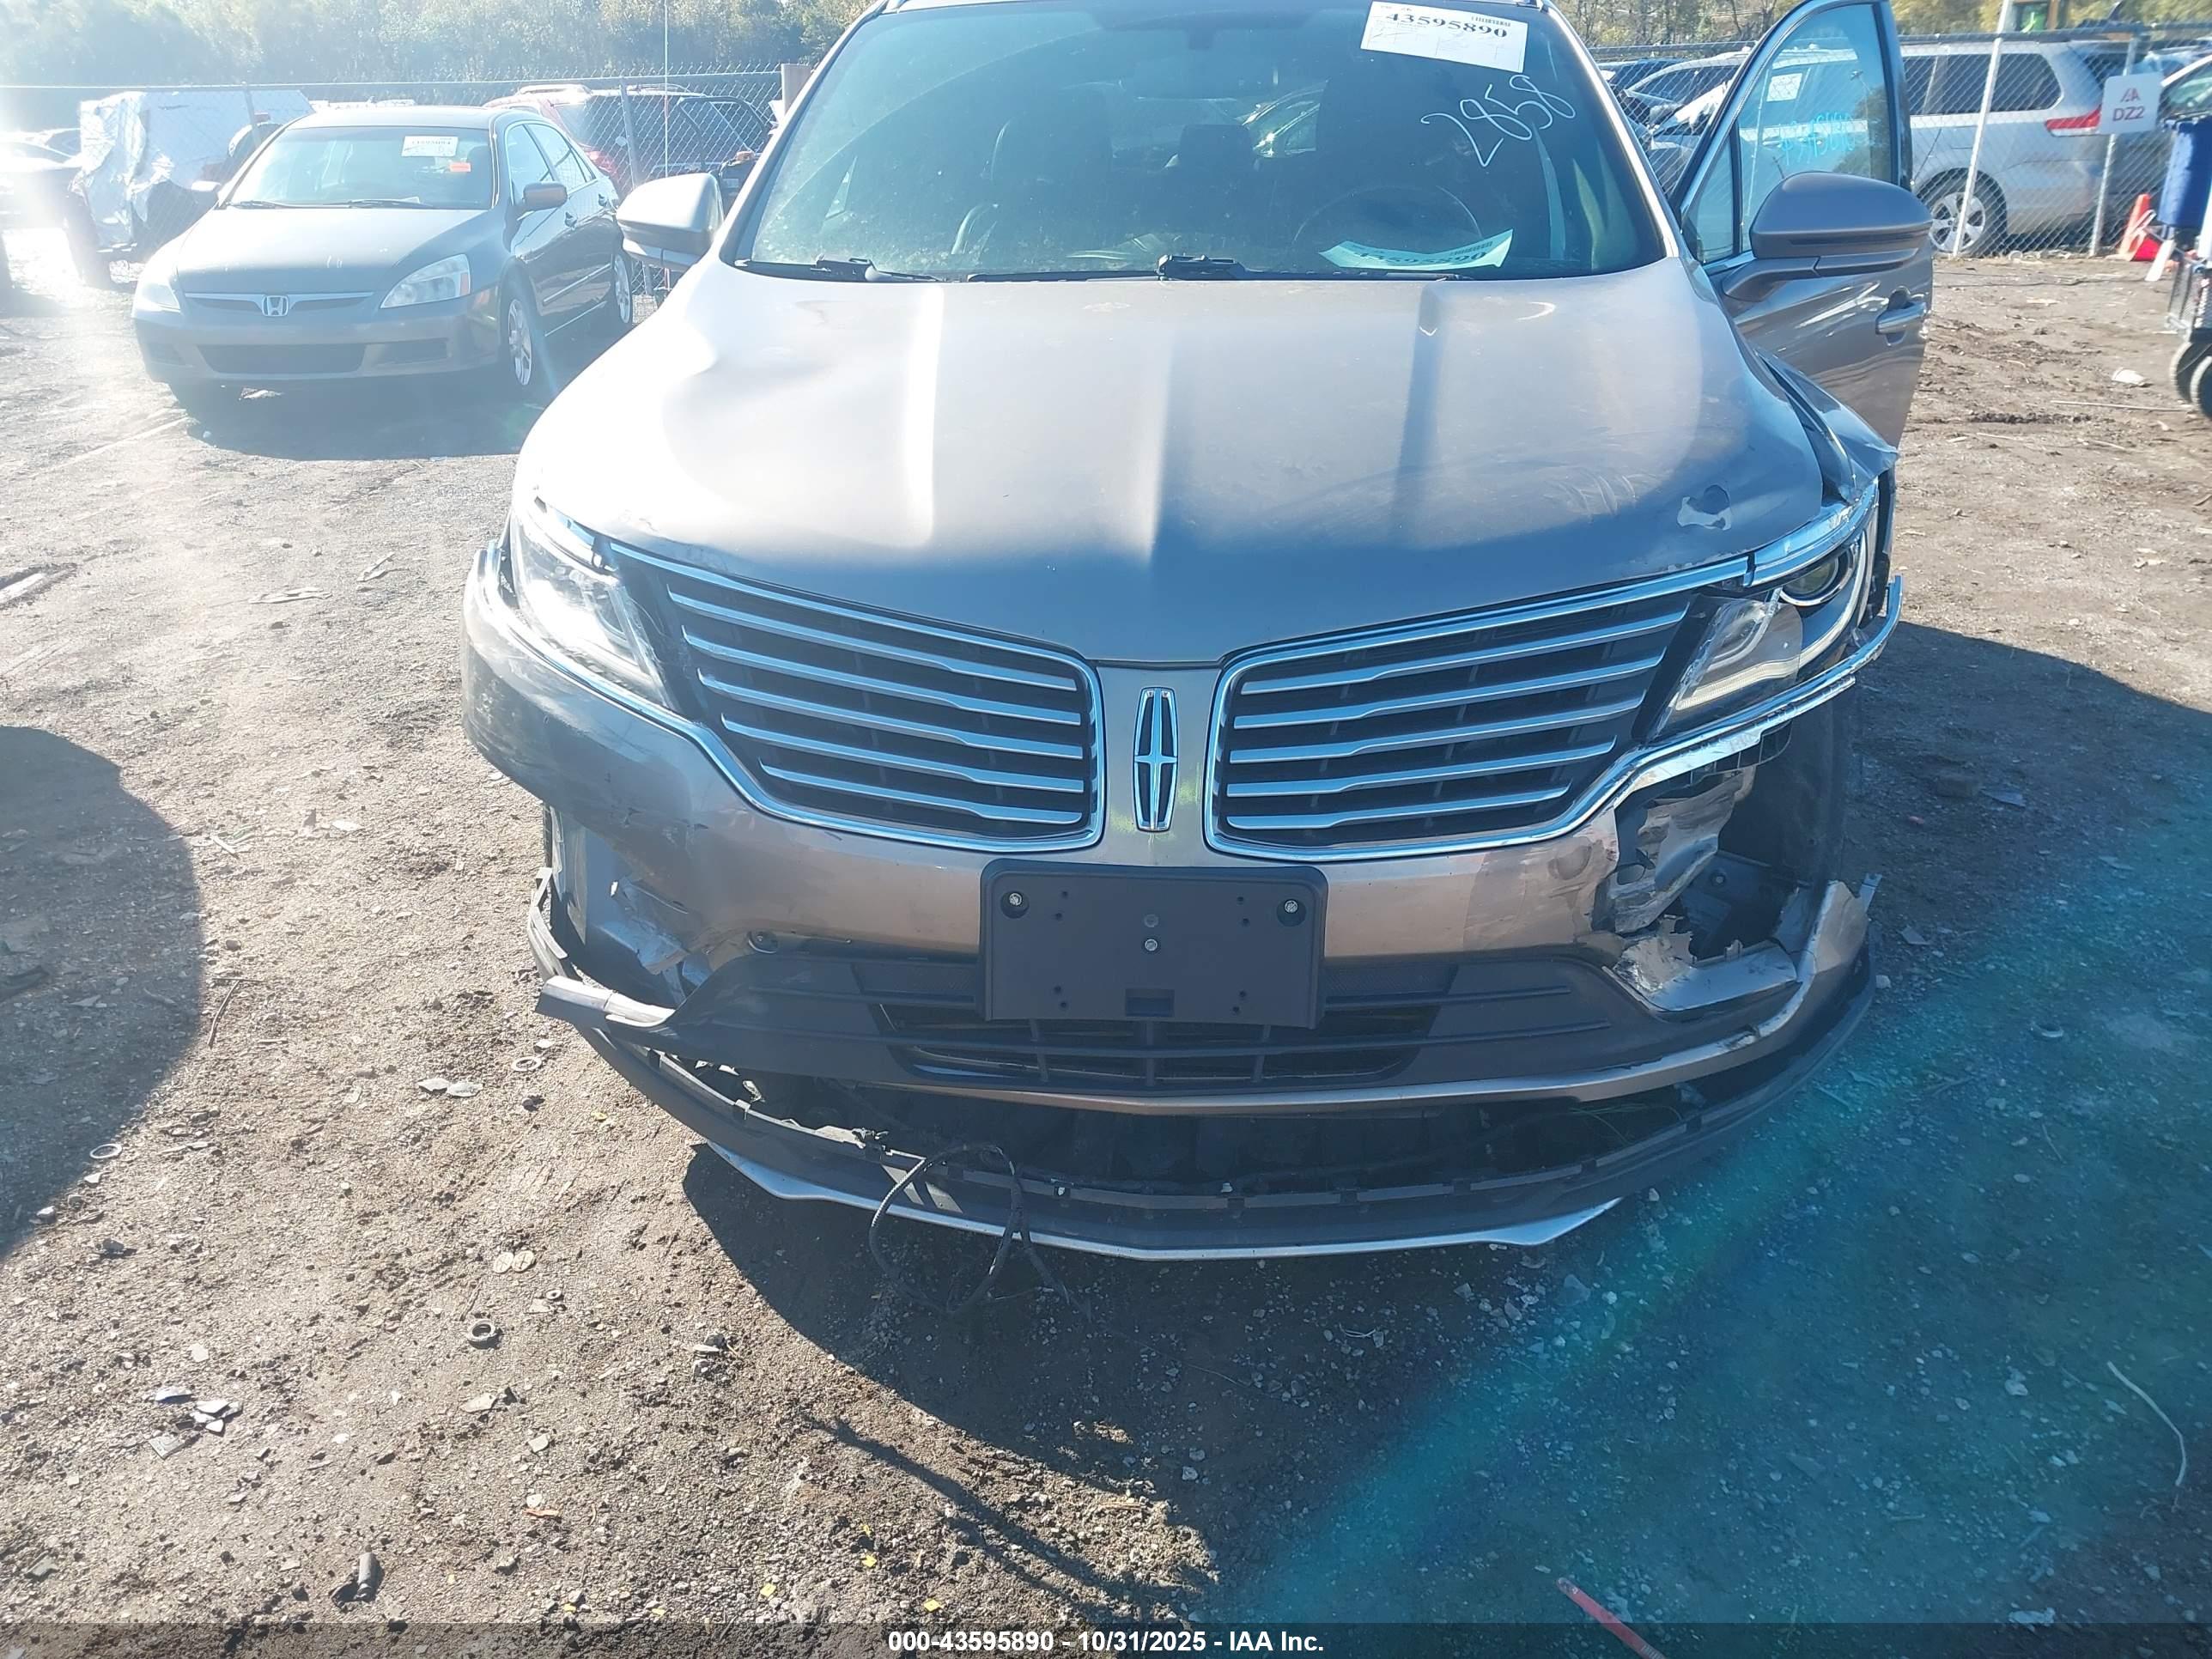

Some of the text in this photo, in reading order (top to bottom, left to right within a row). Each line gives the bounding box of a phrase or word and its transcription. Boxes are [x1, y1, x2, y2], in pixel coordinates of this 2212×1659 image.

[1385, 12, 1508, 38] 43595890
[1420, 74, 1577, 167] 2858
[2113, 106, 2145, 121] DZ2
